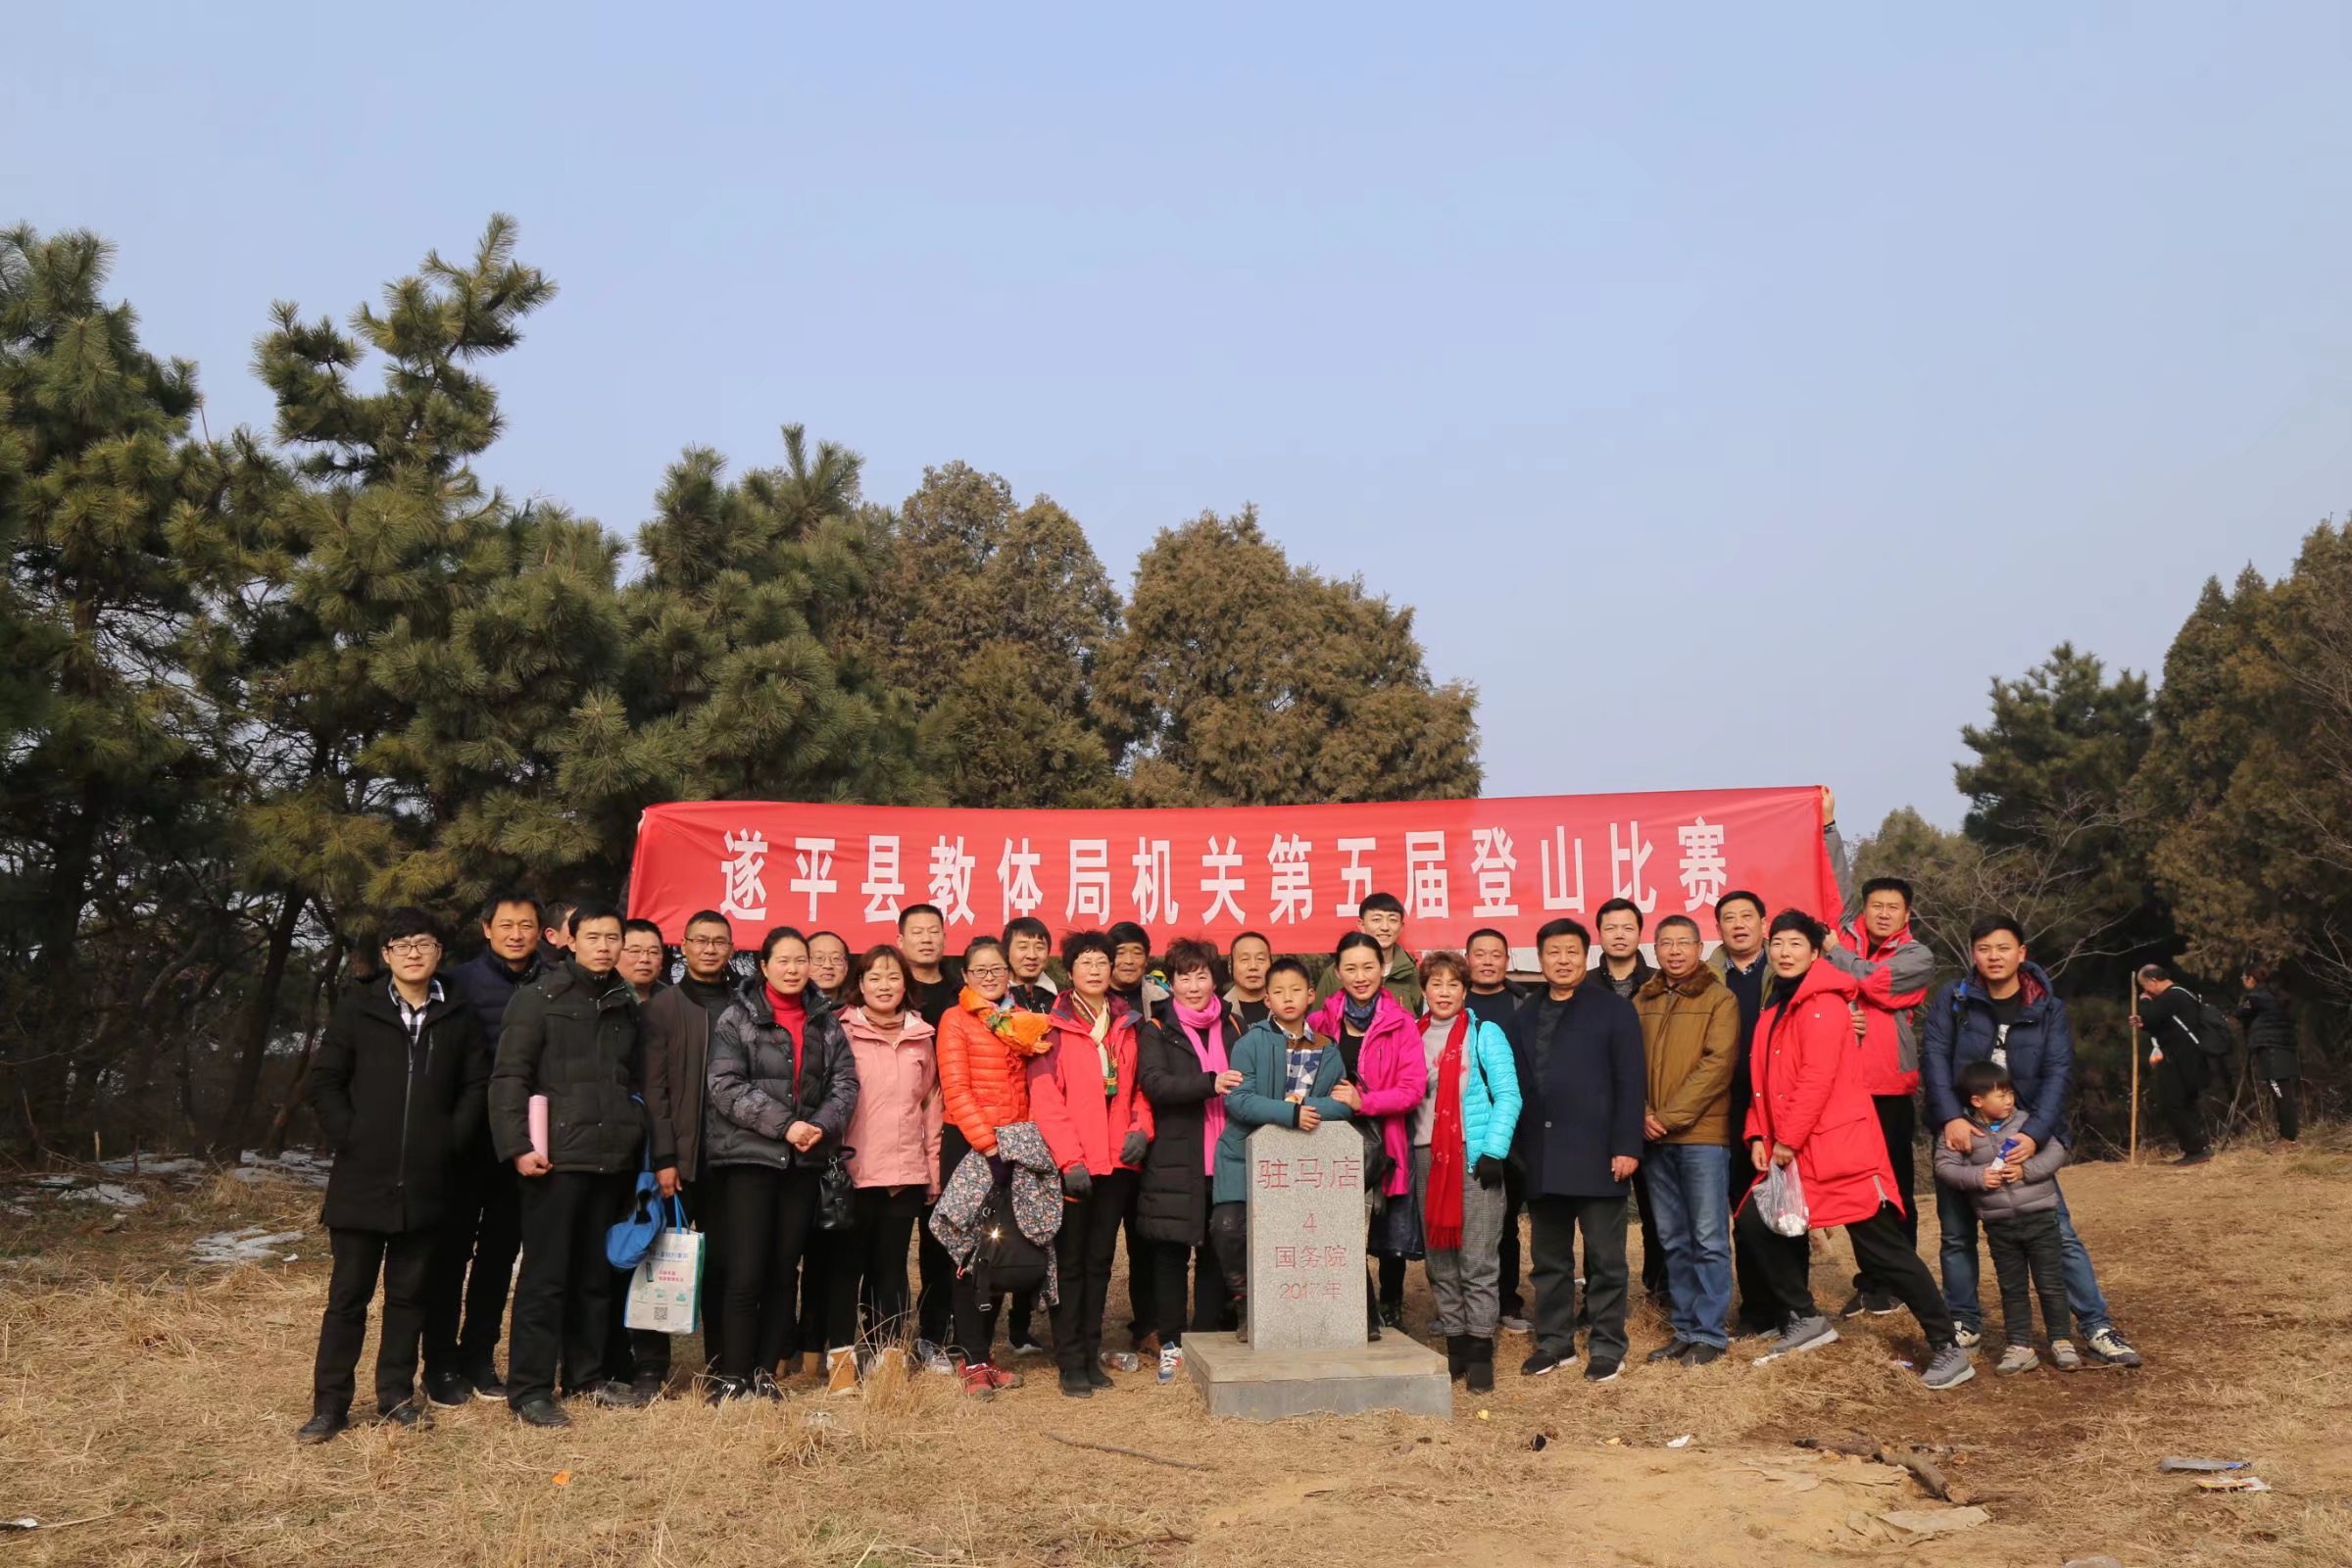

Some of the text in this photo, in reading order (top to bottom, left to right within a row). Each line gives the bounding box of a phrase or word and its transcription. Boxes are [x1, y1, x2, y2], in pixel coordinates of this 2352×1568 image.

[719, 815, 1728, 926] 遂平县教体局机关第五届登山比赛
[1257, 1156, 1361, 1190] 驻马店
[1302, 1212, 1317, 1233] 4
[1275, 1245, 1348, 1269] 国务院
[1279, 1280, 1343, 1301] 2017年
